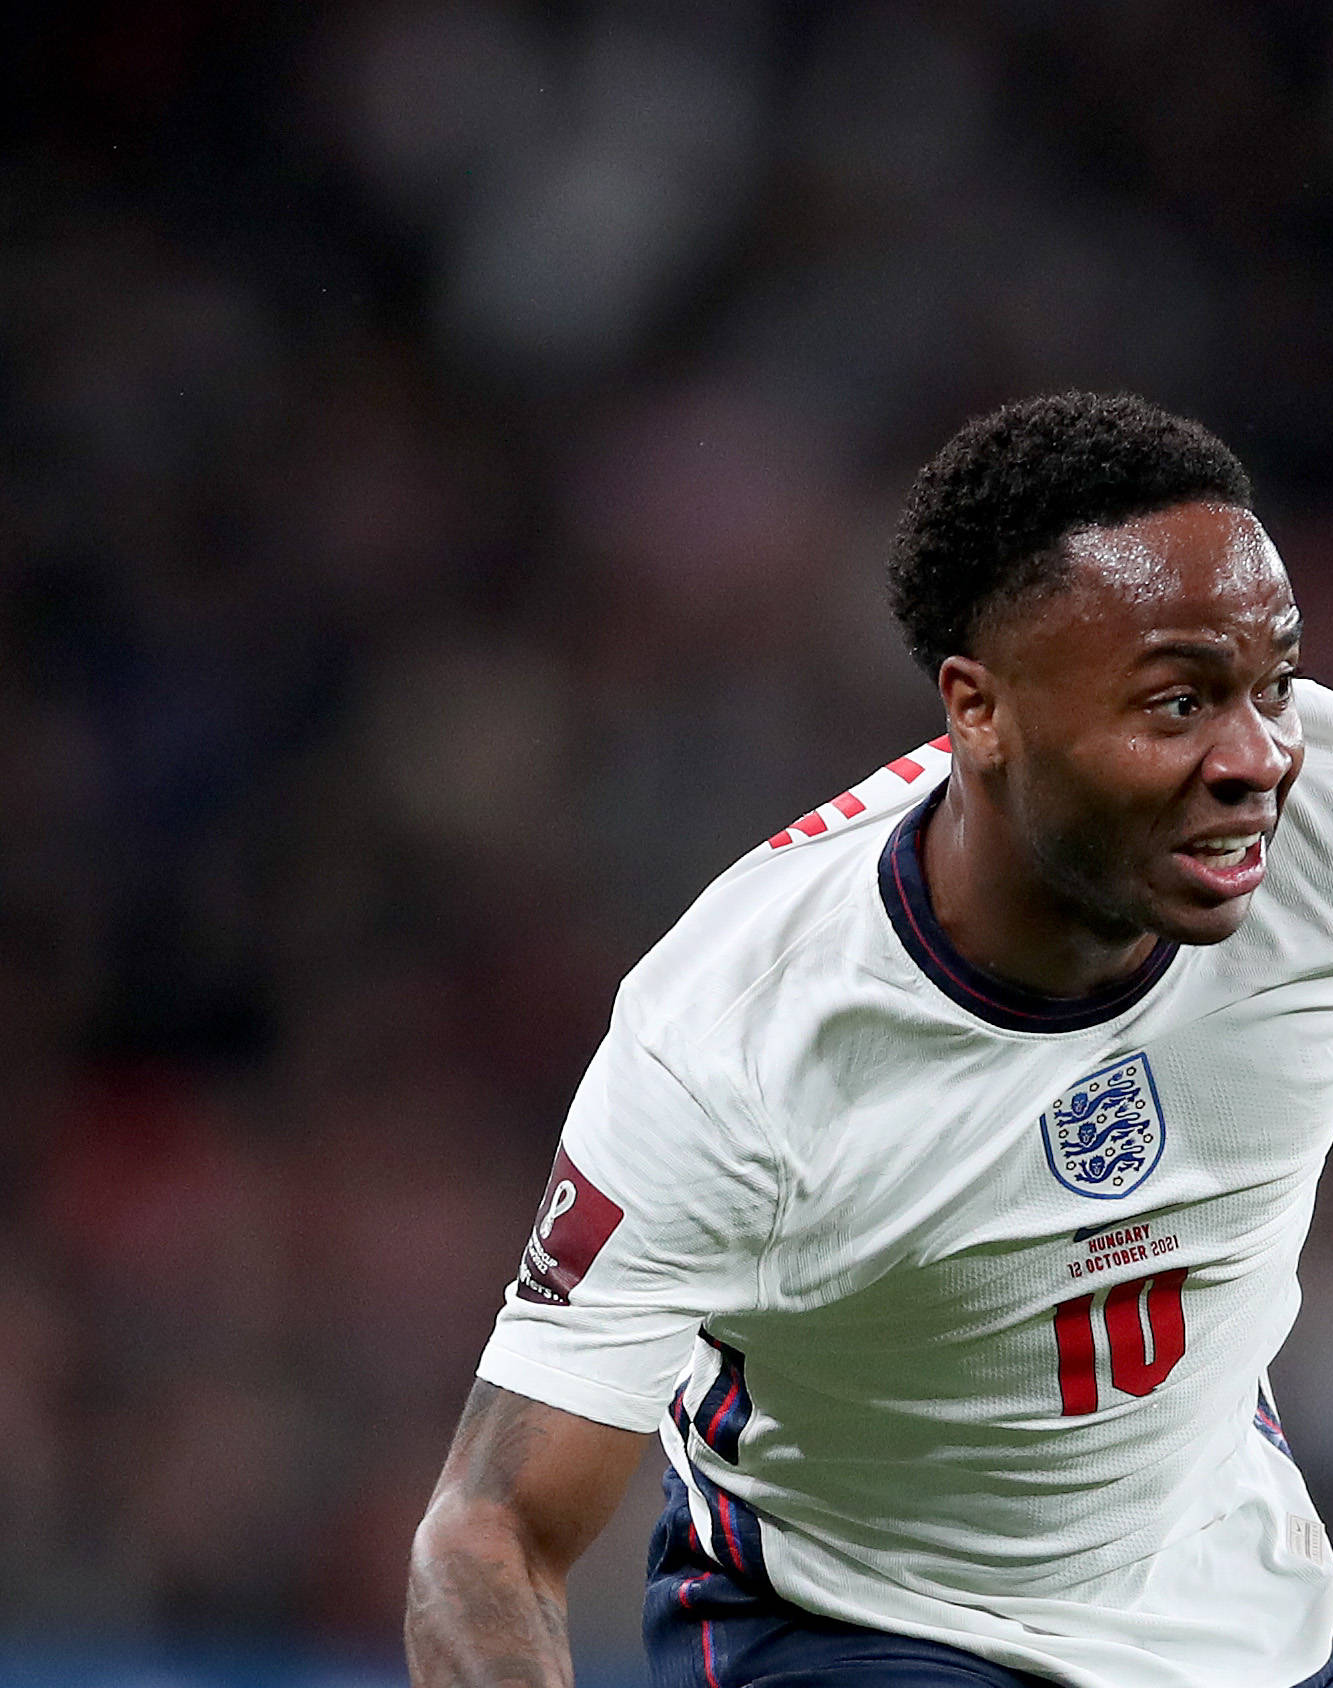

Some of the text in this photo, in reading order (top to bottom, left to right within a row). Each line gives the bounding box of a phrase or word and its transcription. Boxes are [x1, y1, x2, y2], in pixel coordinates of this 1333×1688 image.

[1067, 1234, 1179, 1278] 12 OCTOBER 2021
[1088, 1223, 1150, 1253] HUNGARY
[1053, 1267, 1188, 1417] 10
